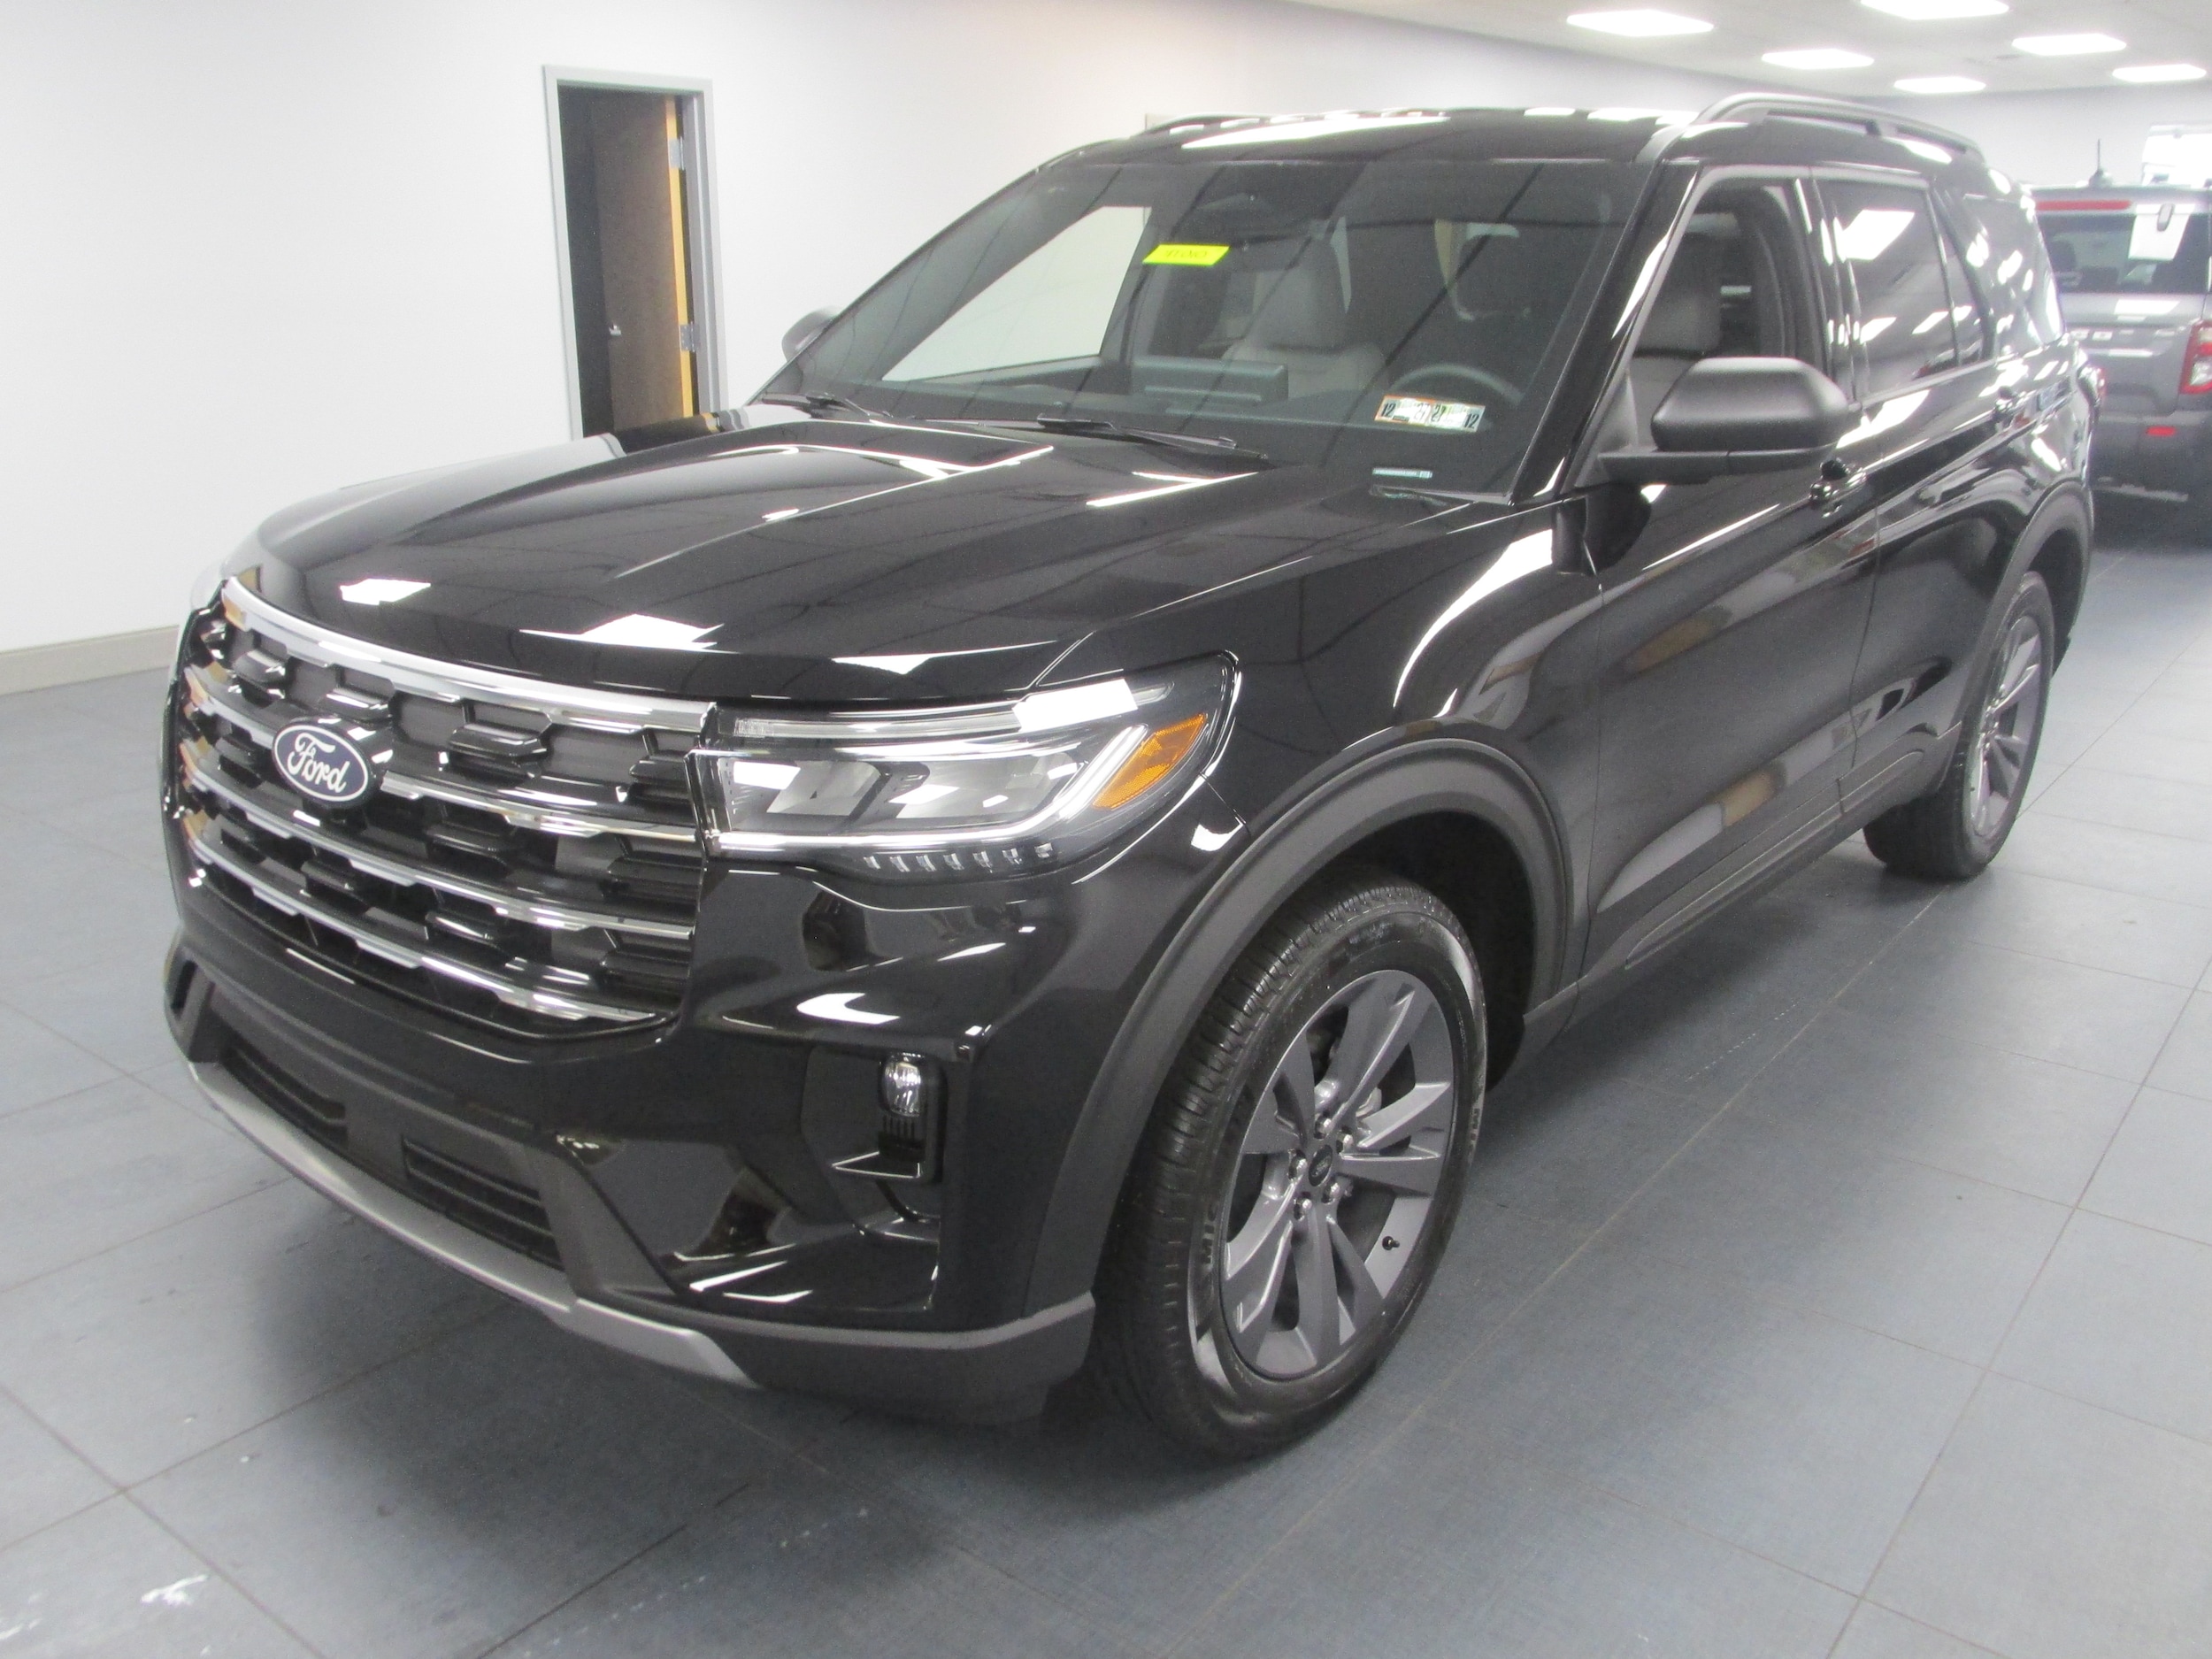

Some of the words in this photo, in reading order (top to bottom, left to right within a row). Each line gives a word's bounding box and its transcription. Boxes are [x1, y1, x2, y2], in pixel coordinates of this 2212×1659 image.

[1380, 403, 1397, 418] 12
[1431, 403, 1447, 422] 27
[1463, 413, 1480, 429] 12
[287, 732, 350, 794] Ford
